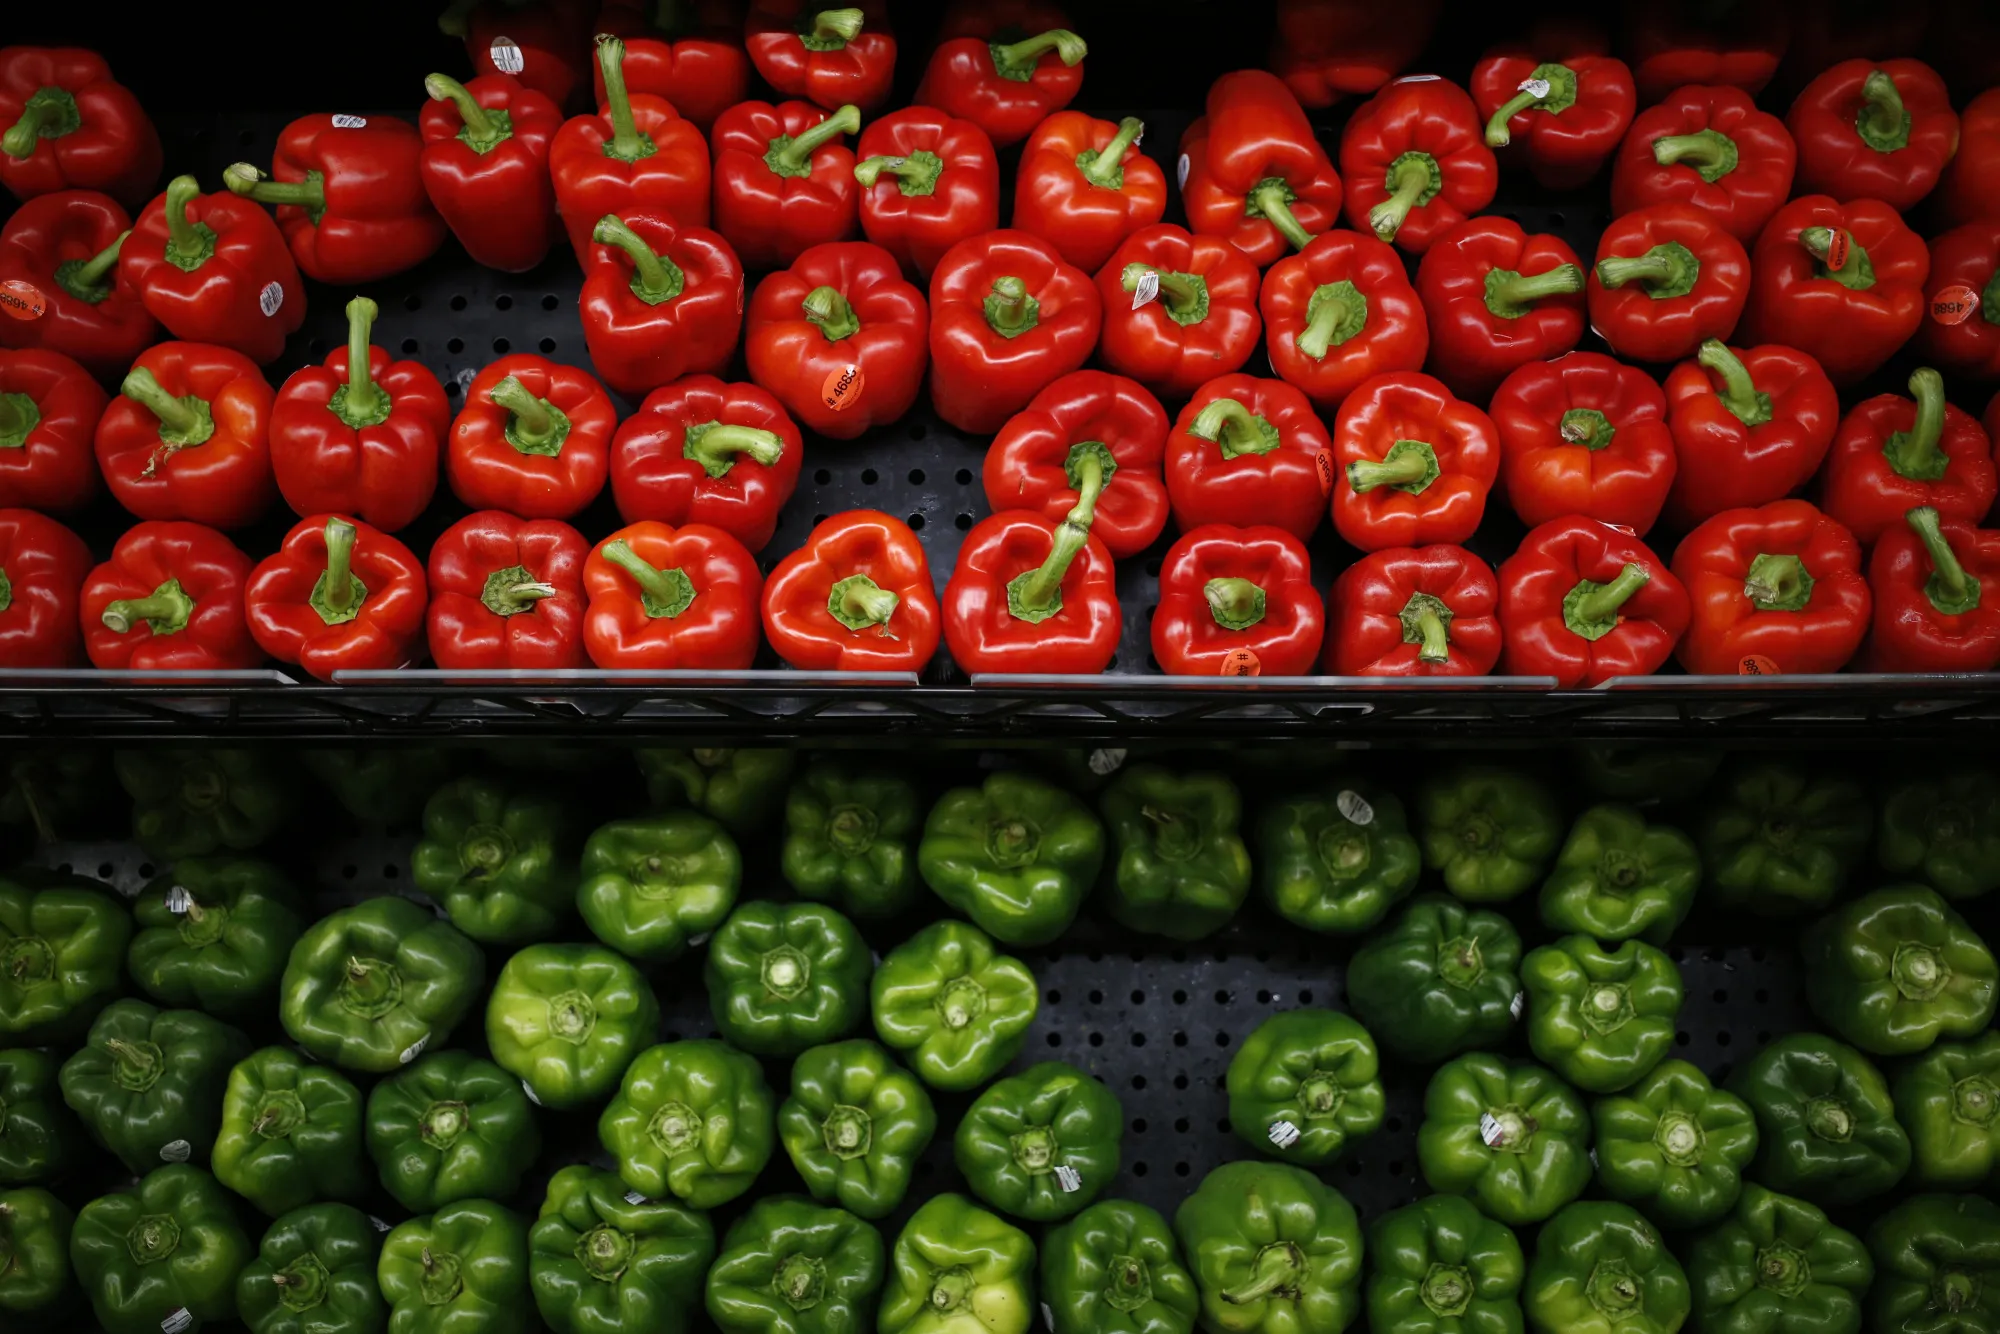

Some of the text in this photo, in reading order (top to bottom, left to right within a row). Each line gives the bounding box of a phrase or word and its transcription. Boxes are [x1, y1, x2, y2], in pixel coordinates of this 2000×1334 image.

[1934, 301, 1964, 315] 4688
[826, 396, 836, 406] #
[1237, 653, 1248, 661] #
